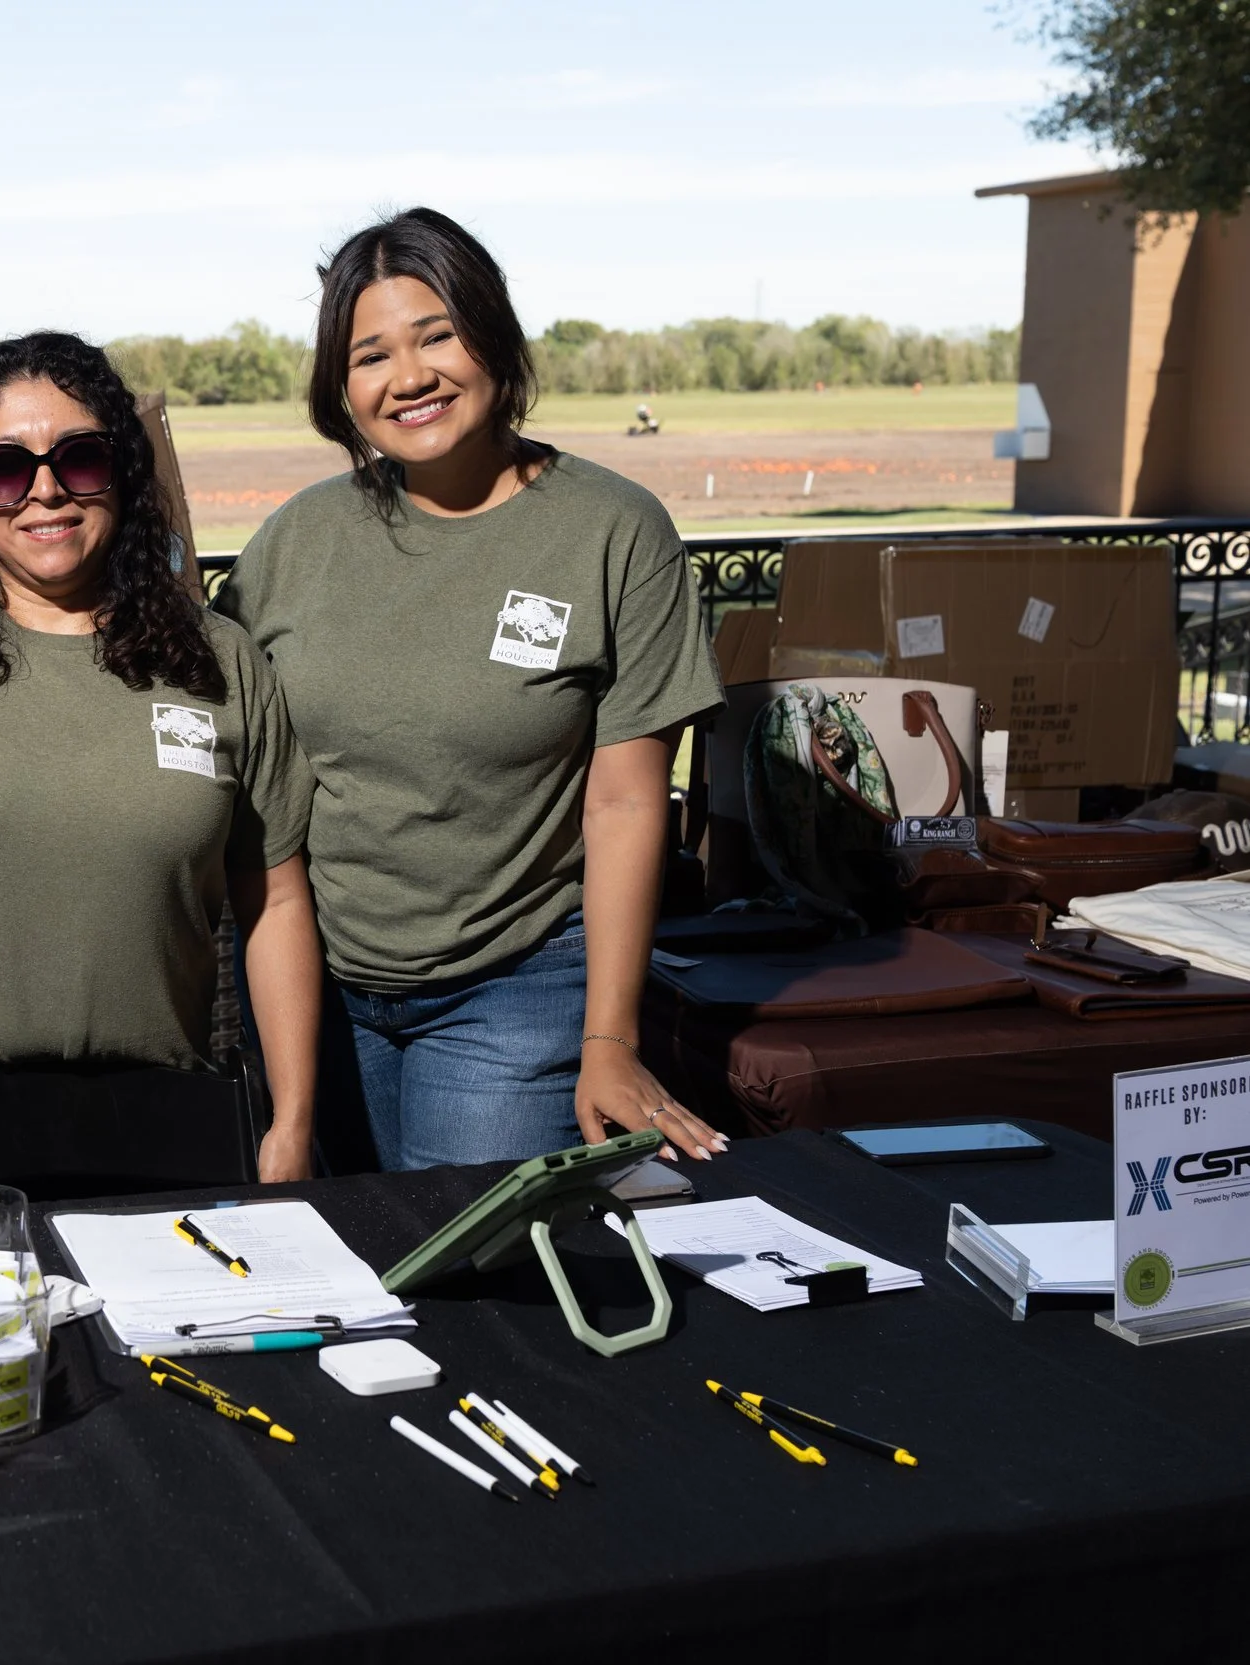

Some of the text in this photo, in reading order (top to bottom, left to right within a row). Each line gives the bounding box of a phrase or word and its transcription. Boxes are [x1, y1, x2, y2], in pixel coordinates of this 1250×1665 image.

[496, 650, 552, 665] HOUSTON
[163, 757, 212, 772] HOUSTON
[923, 829, 937, 838] KING
[937, 829, 956, 838] RANCH
[1125, 1075, 1250, 1110] RAFFLE SPONSOR
[1184, 1106, 1206, 1125] BY:
[1193, 1194, 1221, 1205] Powered
[1222, 1193, 1230, 1202] by
